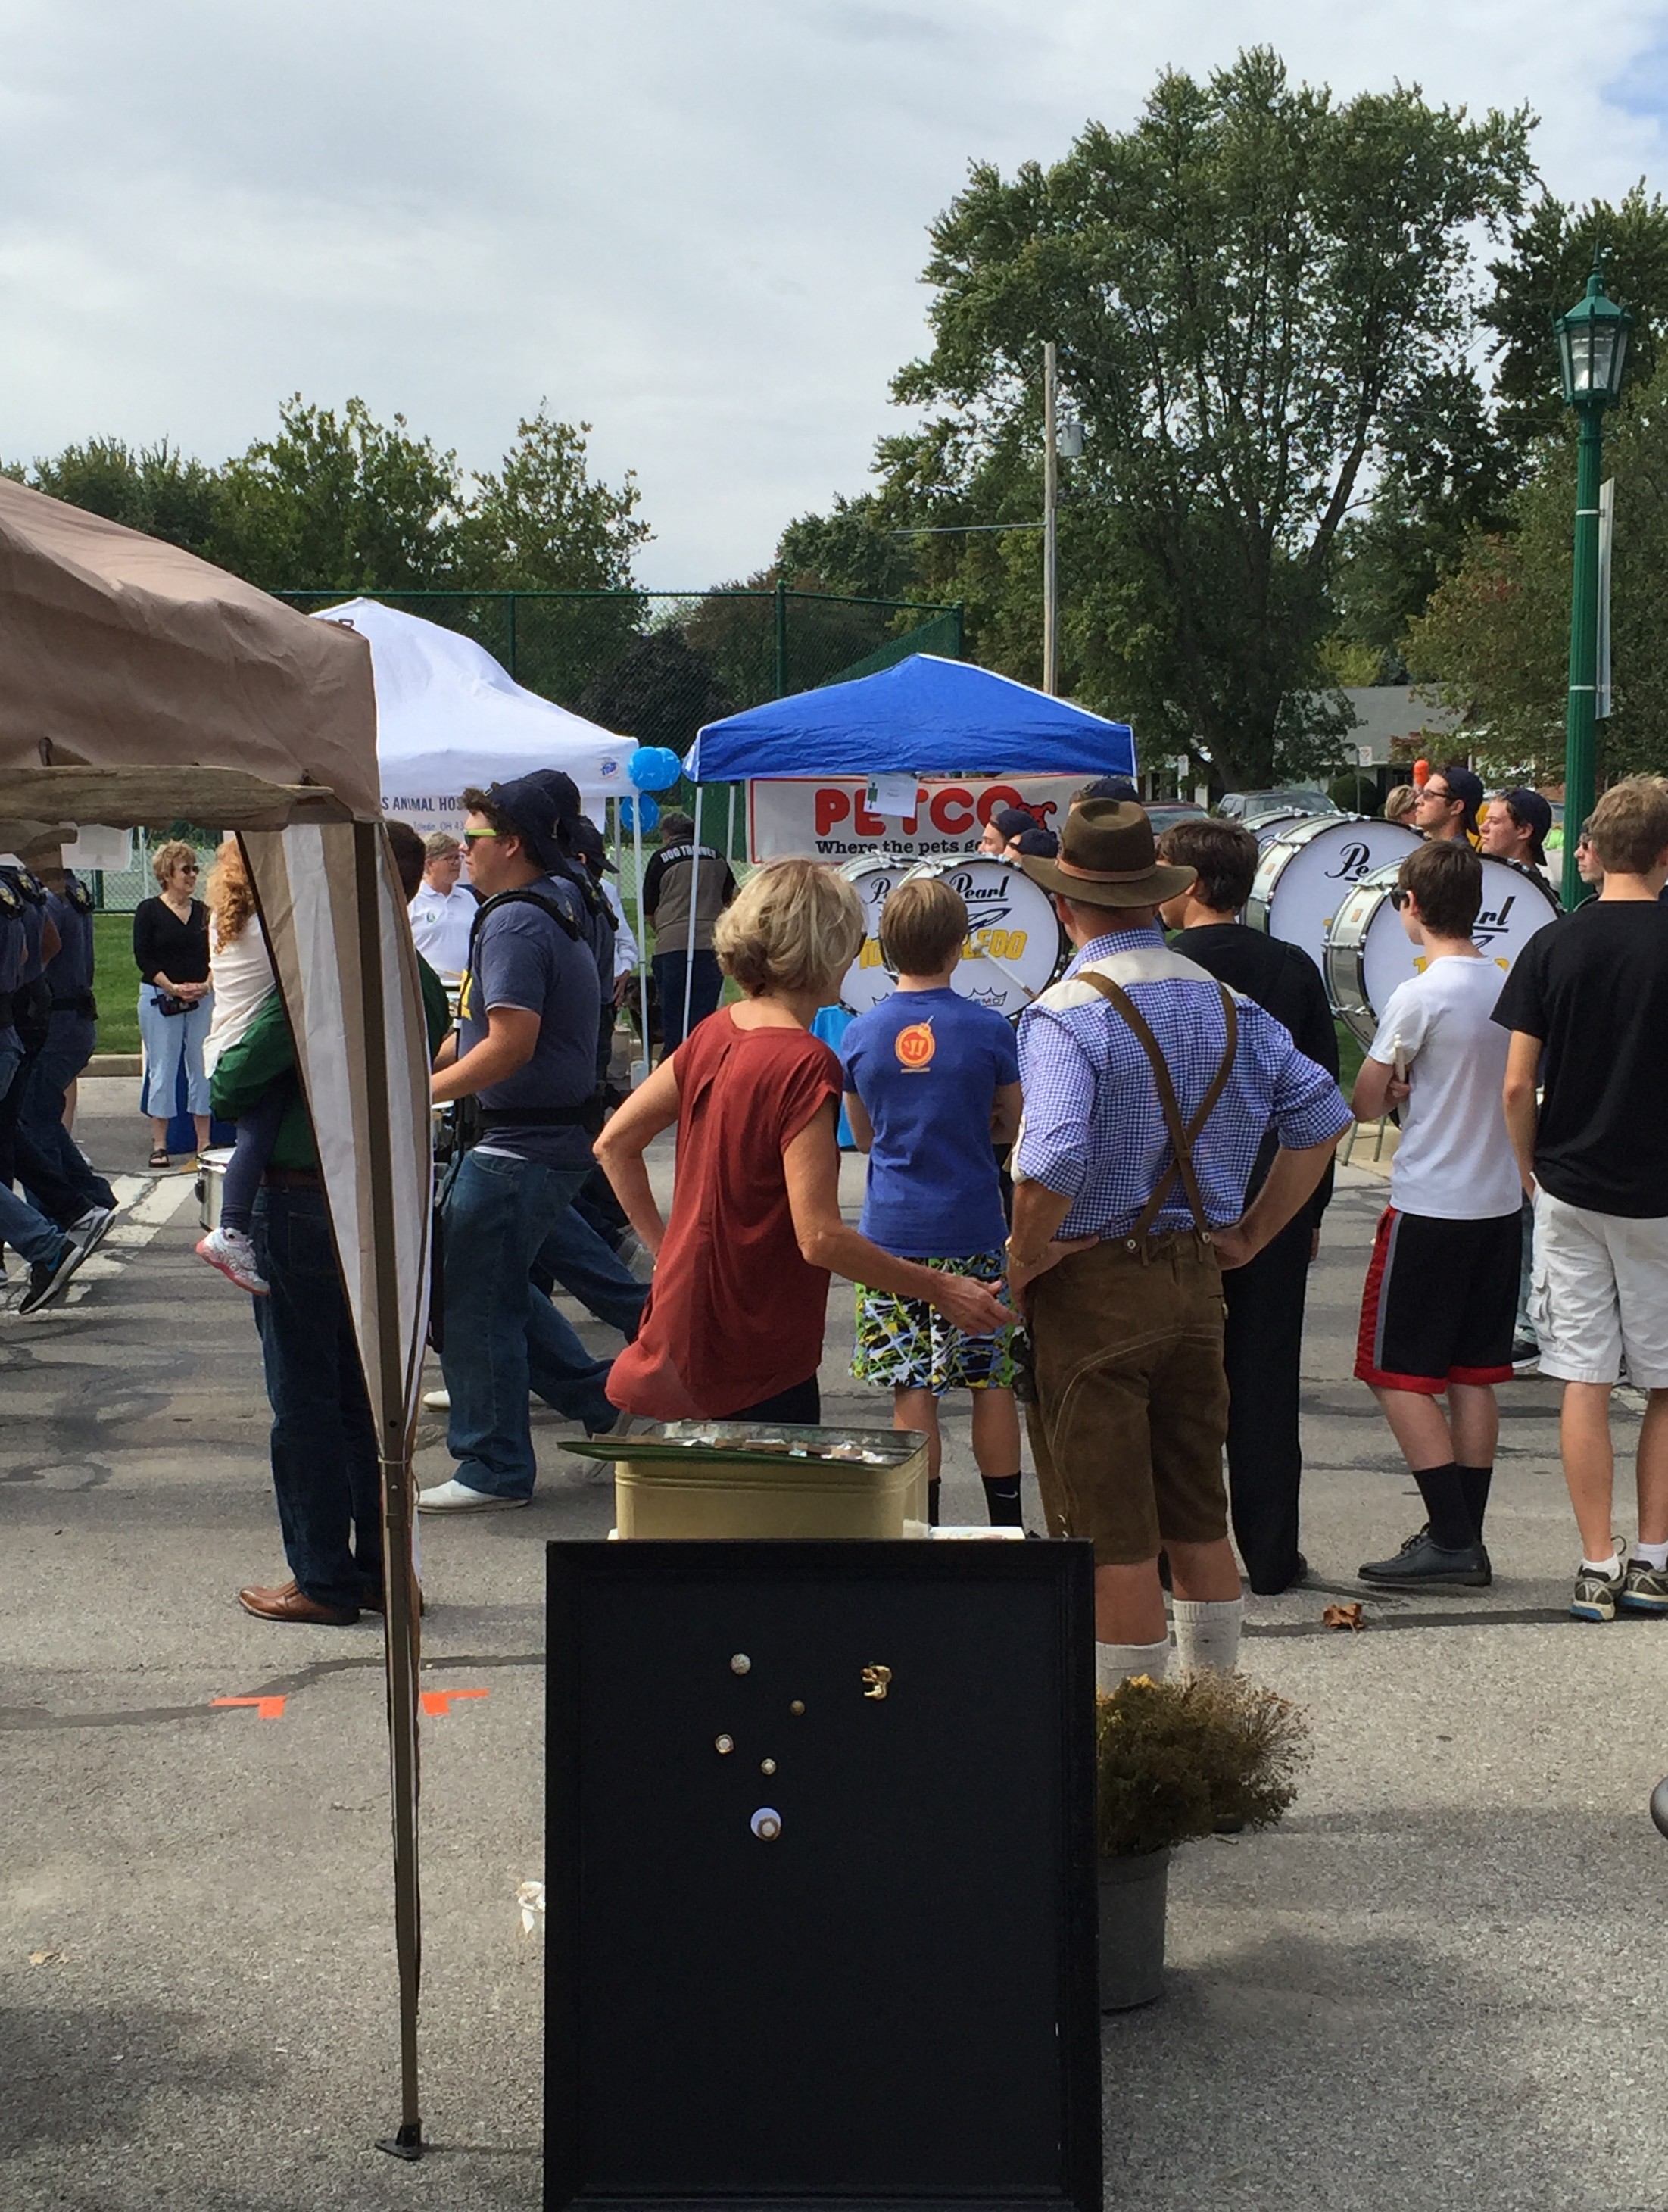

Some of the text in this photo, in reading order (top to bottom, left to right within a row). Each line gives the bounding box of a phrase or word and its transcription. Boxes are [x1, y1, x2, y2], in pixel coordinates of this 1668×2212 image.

[392, 797, 435, 812] ANIMAL
[660, 847, 681, 863] DOG
[815, 841, 878, 854] Where
[882, 840, 913, 853] the
[918, 839, 959, 856] pets
[949, 872, 1010, 900] Pearl
